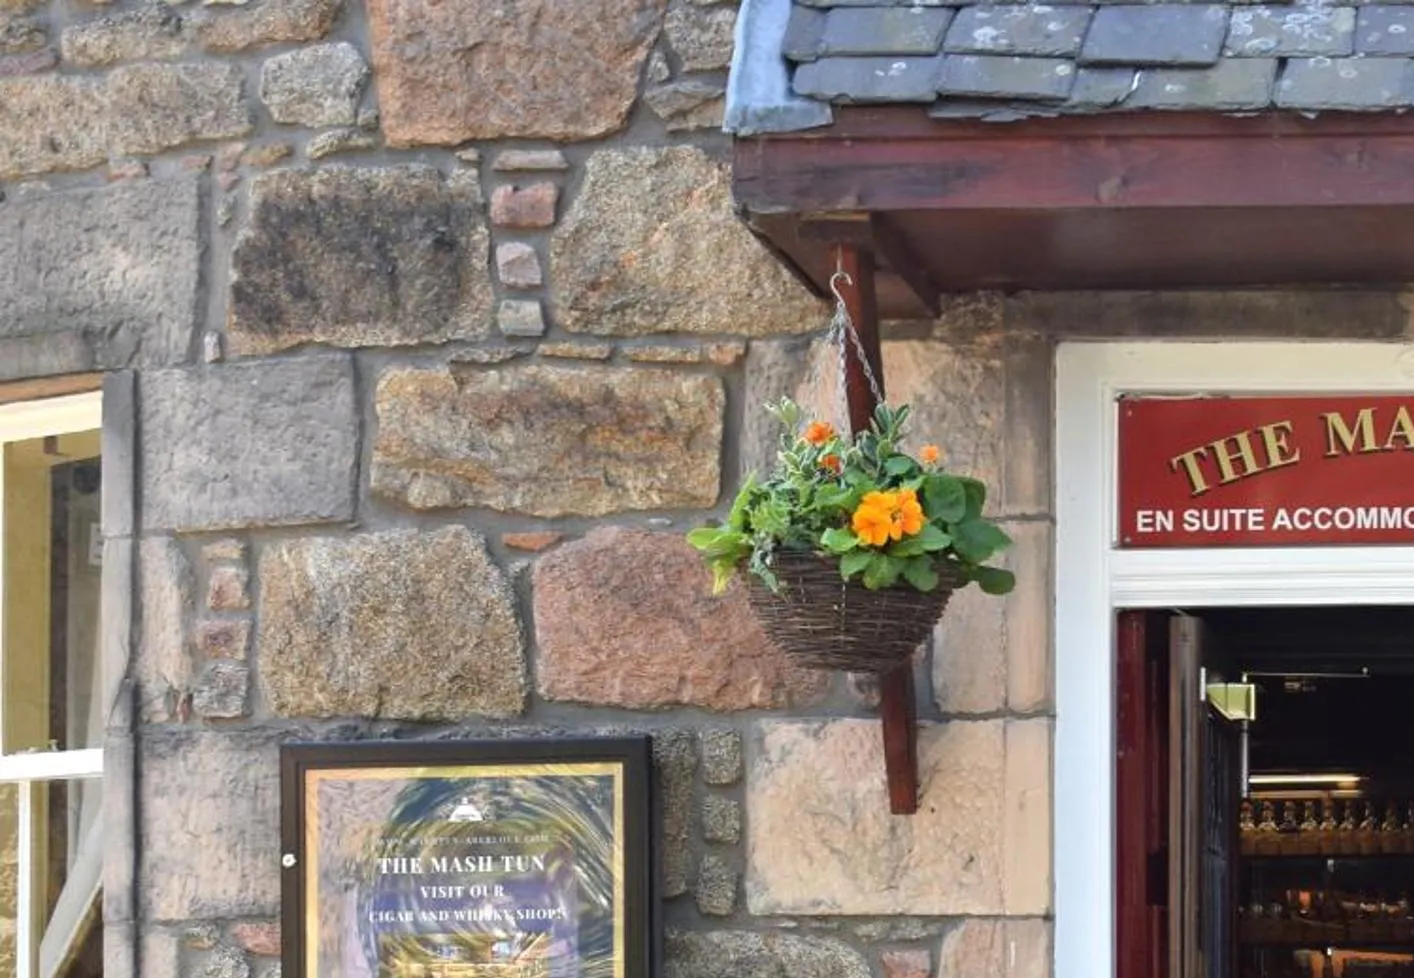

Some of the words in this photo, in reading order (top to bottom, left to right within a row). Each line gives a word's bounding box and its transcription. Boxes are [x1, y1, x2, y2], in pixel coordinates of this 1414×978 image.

[1169, 420, 1300, 496] THE
[1136, 509, 1174, 532] EN
[1182, 508, 1266, 531] SUITE
[379, 857, 424, 874] THE
[430, 855, 494, 874] MASH
[500, 853, 546, 872] TUN
[420, 886, 465, 899] VISIT
[469, 884, 506, 898] OUR
[419, 909, 450, 921] AND
